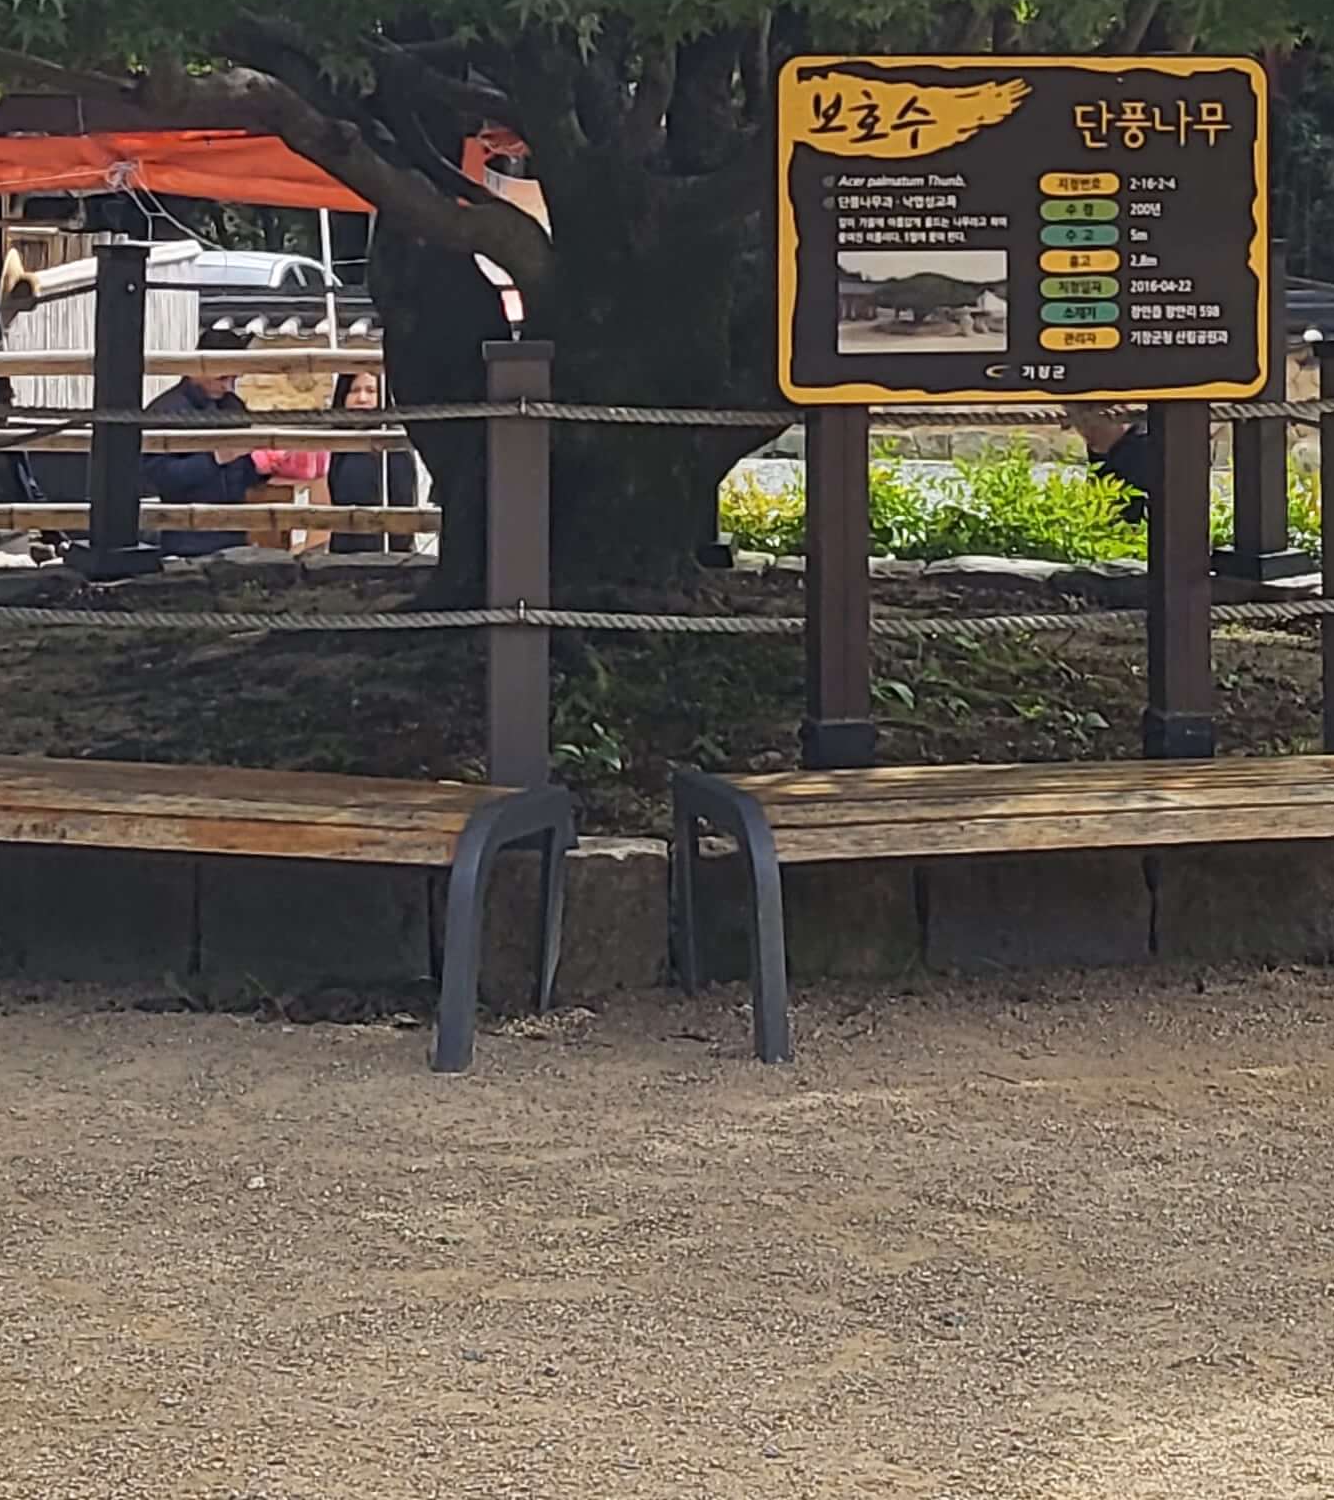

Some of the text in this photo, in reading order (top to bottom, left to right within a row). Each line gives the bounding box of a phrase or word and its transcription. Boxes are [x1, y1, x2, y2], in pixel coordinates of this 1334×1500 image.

[809, 90, 937, 149] 보호수
[1074, 100, 1233, 148] 단풍나무
[838, 175, 865, 187] Acer
[867, 175, 924, 188] palmatum
[1058, 177, 1101, 191] 지정번호
[1129, 177, 1177, 190] 2-16-2-4
[1129, 203, 1161, 217] 200년
[1058, 280, 1102, 294] 지정일자
[1129, 280, 1192, 293] 2016-04-22
[1063, 306, 1097, 320] 소재지
[1063, 332, 1097, 346] 관리자
[1021, 365, 1066, 380] 기장군
